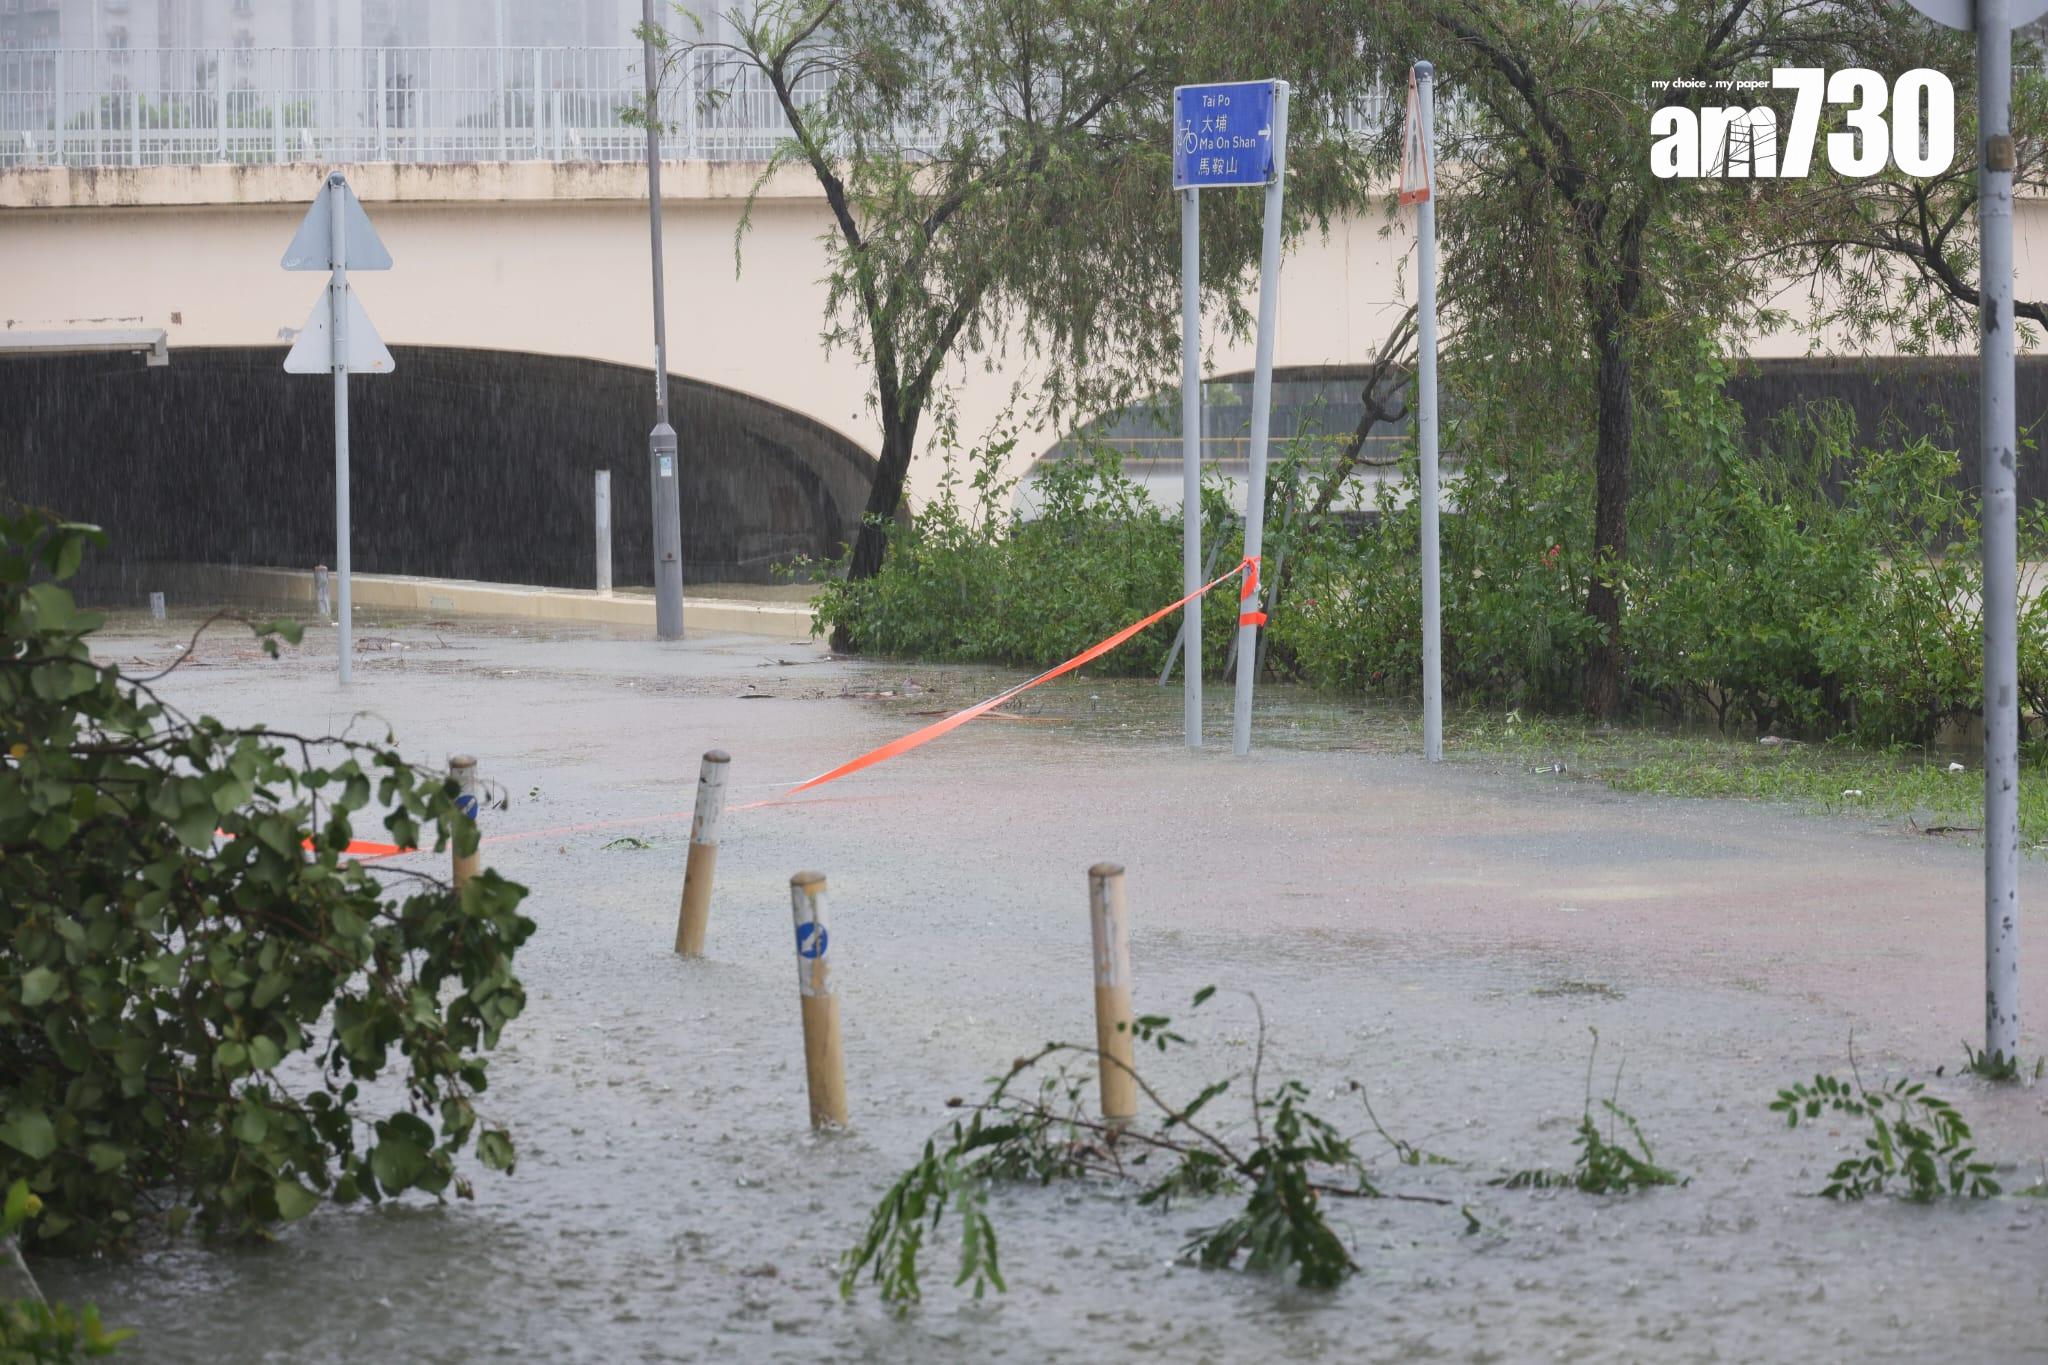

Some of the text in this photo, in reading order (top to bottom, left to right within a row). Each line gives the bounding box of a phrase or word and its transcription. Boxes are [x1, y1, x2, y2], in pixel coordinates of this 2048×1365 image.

[1202, 94, 1230, 107] Tai Po
[1201, 114, 1228, 133] 大埔
[1200, 135, 1256, 150] Ma On Shan
[1199, 156, 1238, 176] 馬鞍山
